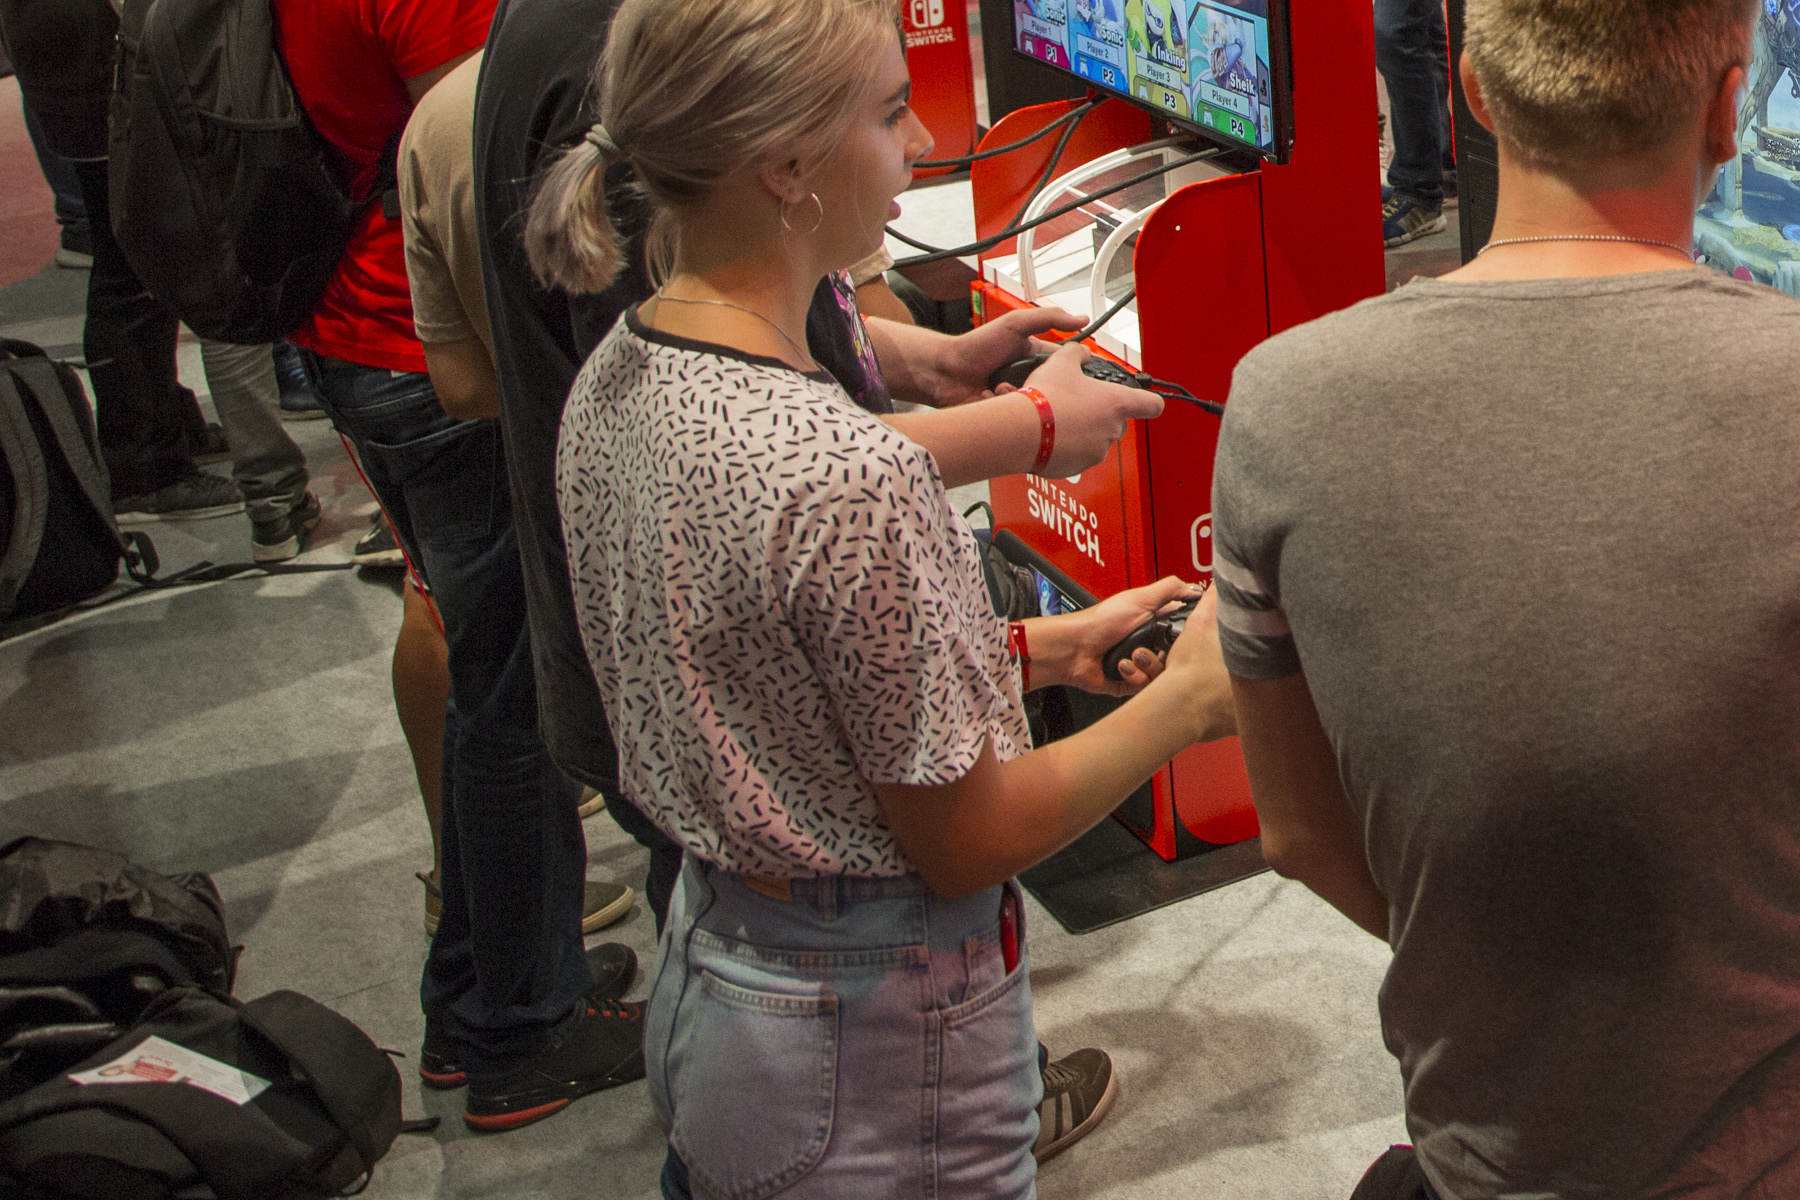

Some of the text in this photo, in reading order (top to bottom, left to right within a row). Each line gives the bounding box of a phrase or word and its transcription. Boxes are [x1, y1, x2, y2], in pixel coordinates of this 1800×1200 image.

[1045, 2, 1066, 24] Sonic
[906, 33, 953, 48] SWITCH
[1101, 24, 1124, 47] Sonic
[1046, 42, 1058, 63] P1
[1087, 41, 1109, 58] Player 2
[1156, 46, 1187, 73] Inkling
[1102, 66, 1115, 85] P2
[1146, 60, 1171, 82] Player 3
[1229, 72, 1256, 96] Sheik
[1163, 92, 1176, 111] P3
[1211, 88, 1238, 108] Player 4
[1230, 118, 1245, 138] P4
[1026, 473, 1098, 529] NINTENDO
[1028, 488, 1100, 565] SWITCH
